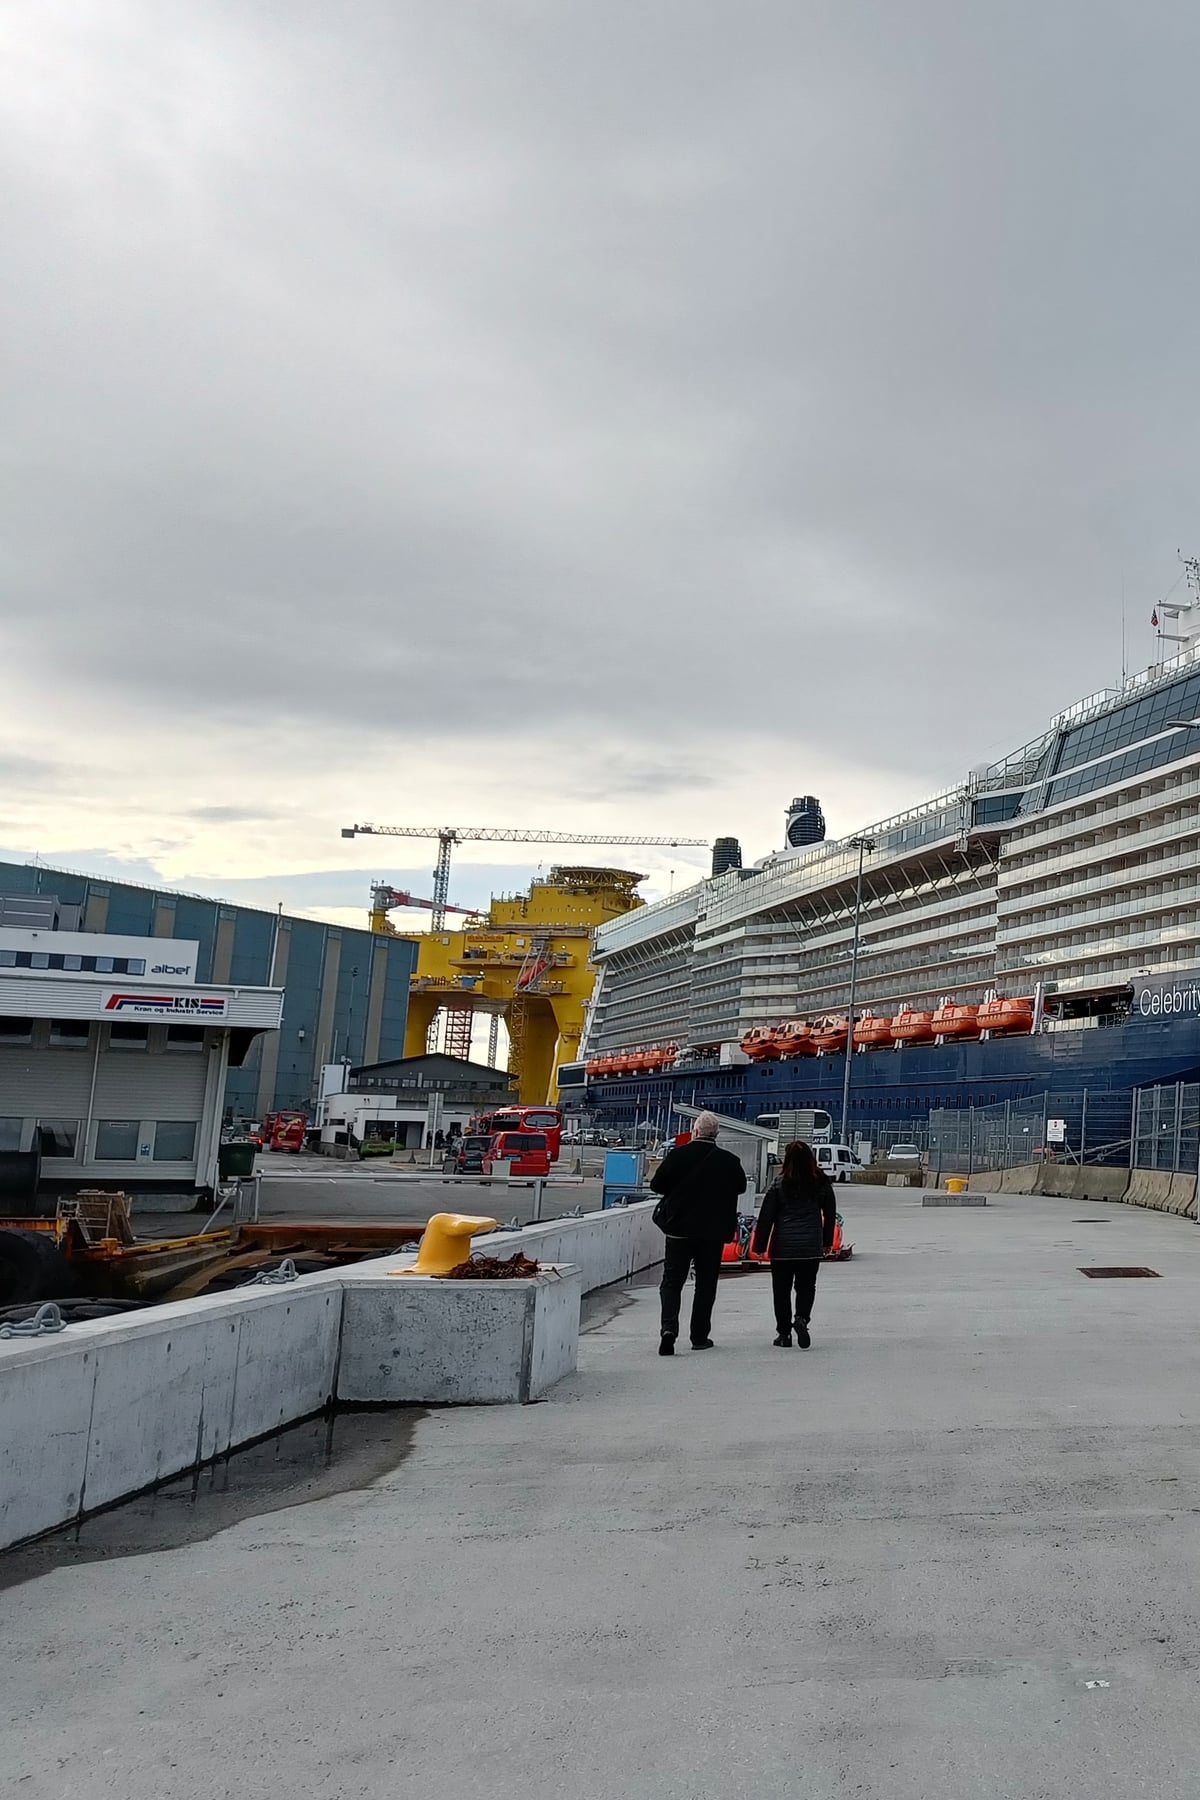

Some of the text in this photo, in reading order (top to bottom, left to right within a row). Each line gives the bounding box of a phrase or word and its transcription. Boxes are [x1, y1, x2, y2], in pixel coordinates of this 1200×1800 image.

[174, 997, 200, 1009] KIS
[166, 1007, 194, 1015] Industri
[196, 1008, 224, 1016] Service
